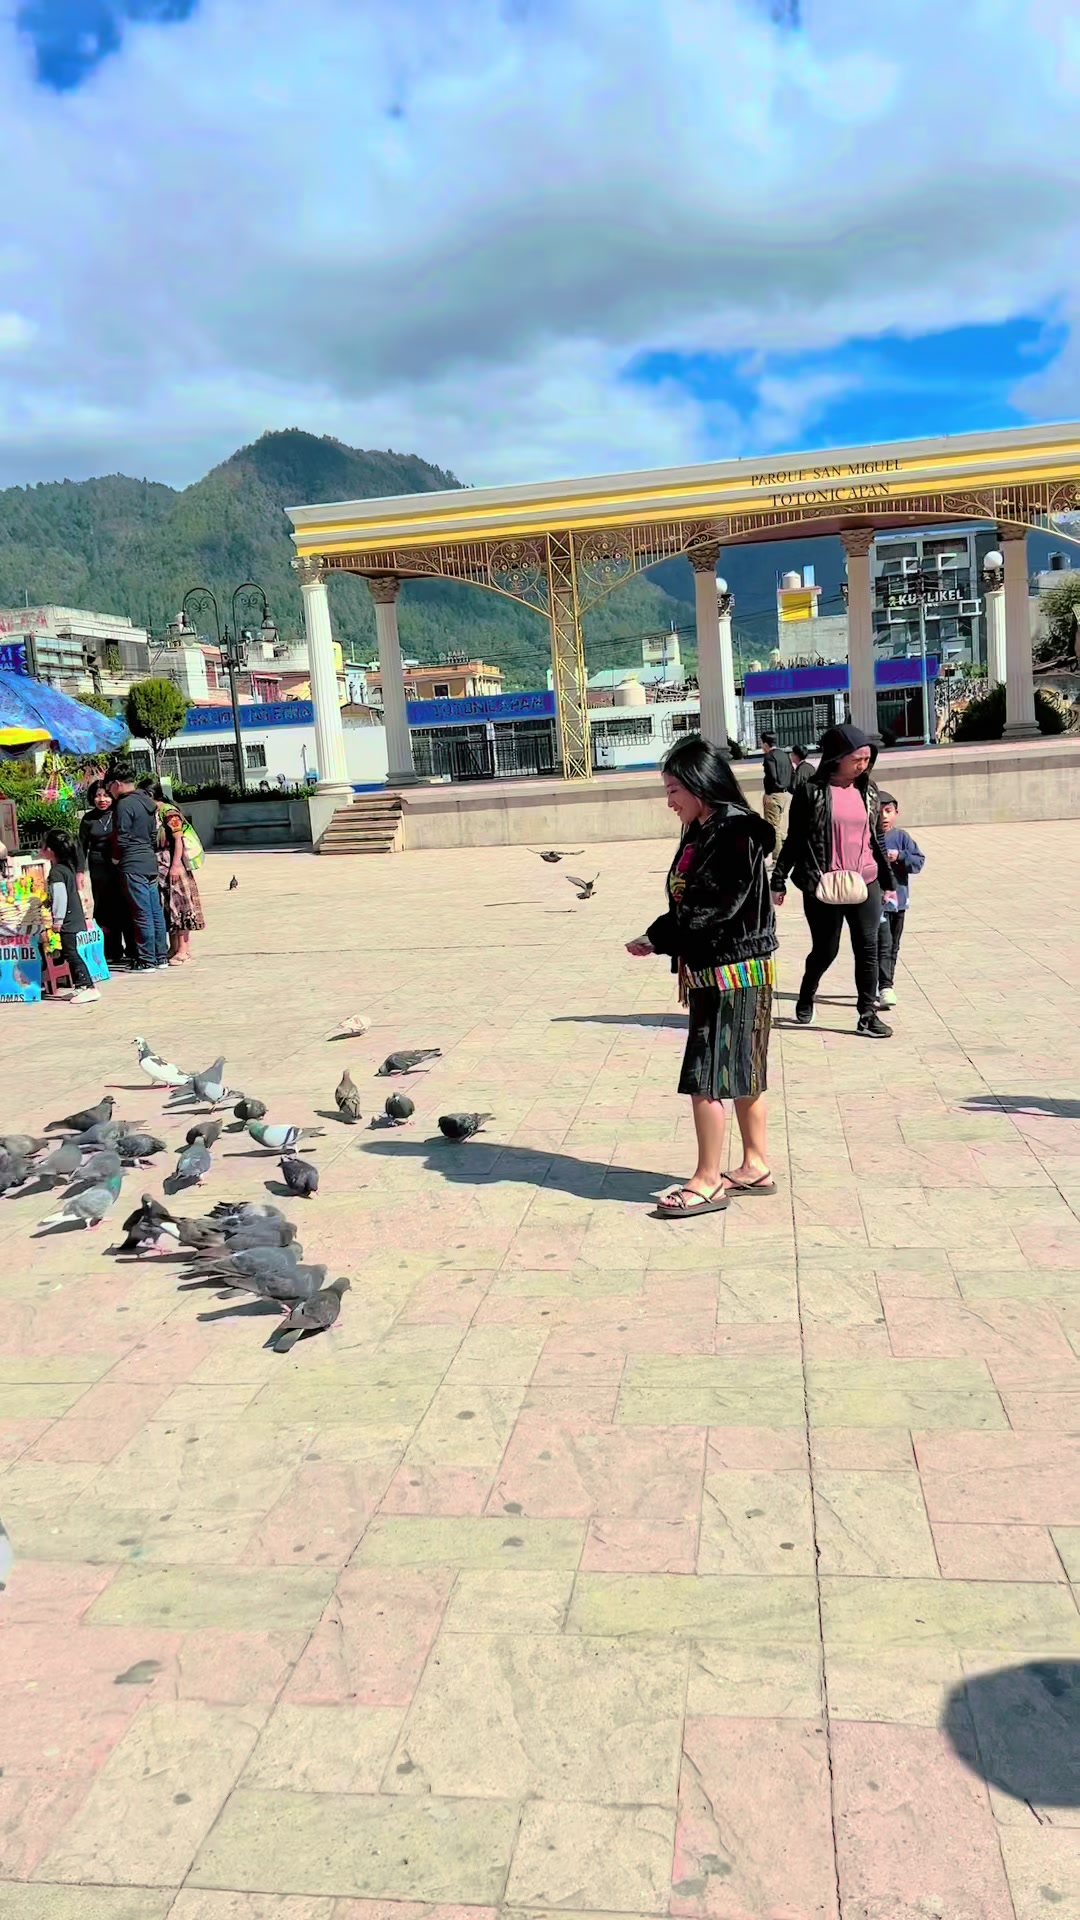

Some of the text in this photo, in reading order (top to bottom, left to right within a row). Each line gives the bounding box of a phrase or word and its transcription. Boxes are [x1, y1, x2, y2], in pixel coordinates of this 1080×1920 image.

[751, 459, 903, 486] PARQUE SAN MIGUEL
[769, 482, 890, 507] TOTONICAPAN
[21, 947, 36, 960] DE
